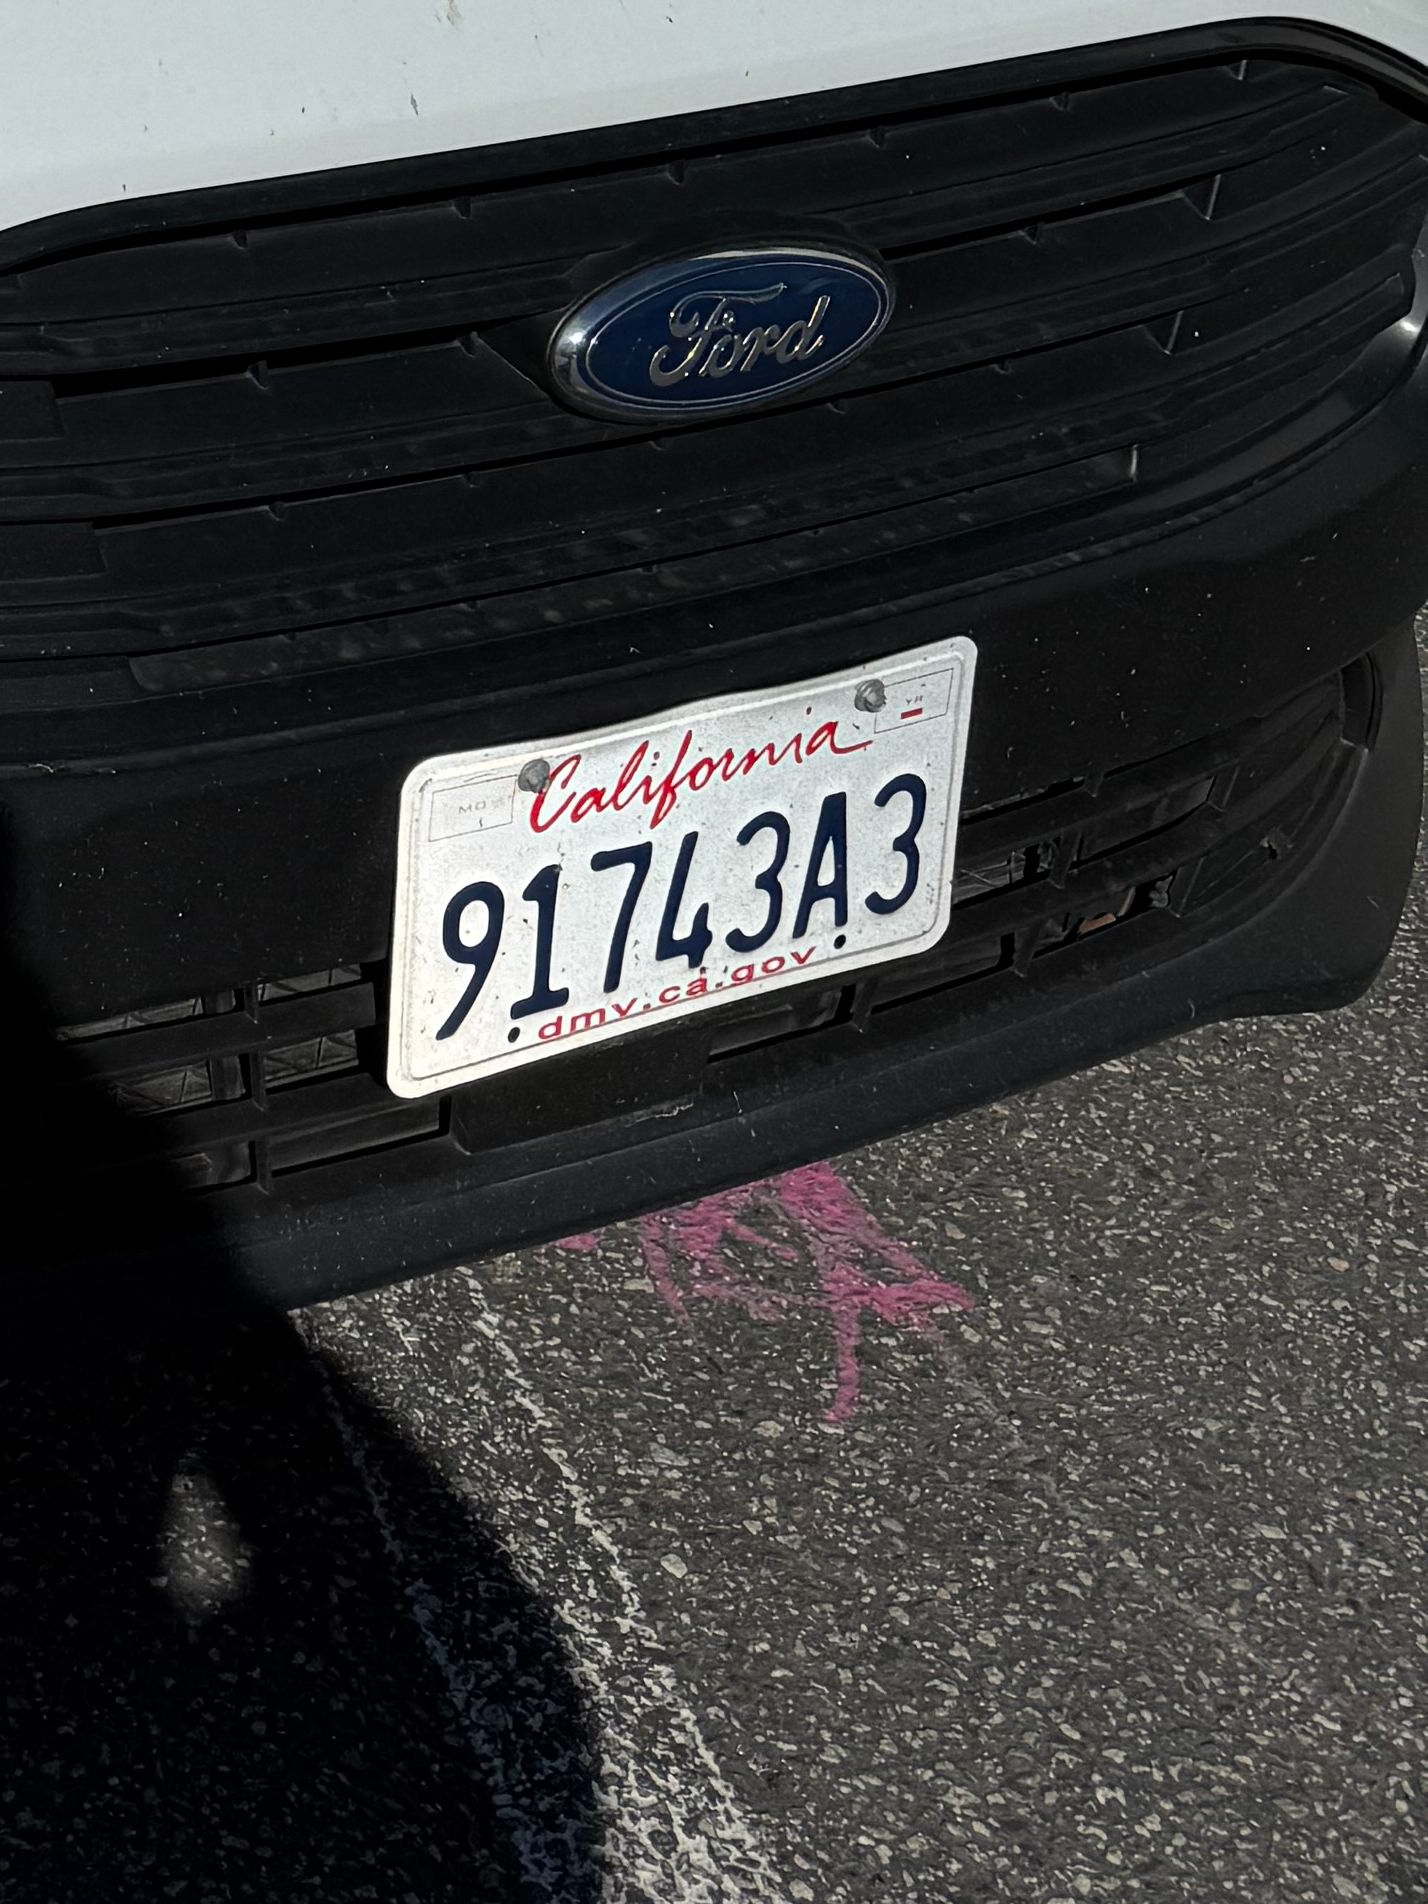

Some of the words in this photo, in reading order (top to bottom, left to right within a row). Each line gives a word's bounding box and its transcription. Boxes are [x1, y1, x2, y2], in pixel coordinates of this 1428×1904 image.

[648, 281, 831, 387] Ford
[529, 706, 873, 834] California
[436, 772, 928, 1041] 91743A3
[539, 945, 818, 1041] dmv.ca.gov
